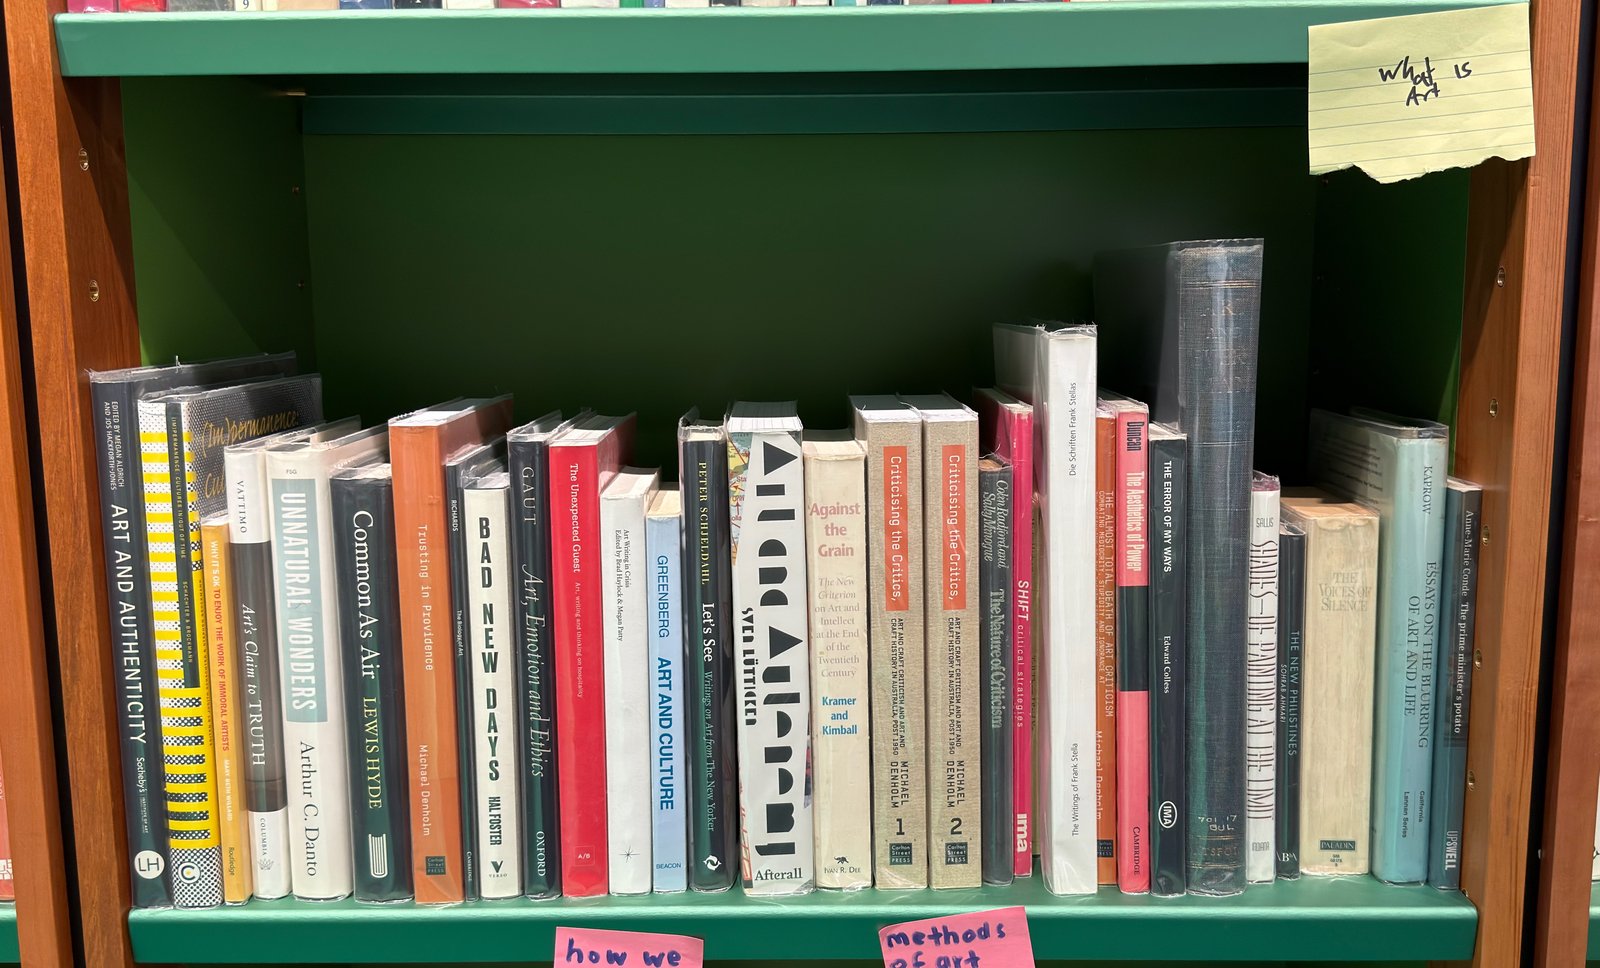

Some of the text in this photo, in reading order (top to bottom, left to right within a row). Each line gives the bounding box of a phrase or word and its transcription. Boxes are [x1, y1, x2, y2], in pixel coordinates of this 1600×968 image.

[1379, 56, 1435, 86] What
[1406, 82, 1440, 106] Art
[111, 401, 124, 488] EDITED BY MEGAN ALDRICH
[1069, 382, 1077, 476] Die Schriften Frank Stellas
[236, 480, 247, 533] VATTIMO
[521, 466, 537, 525] GAUT
[809, 502, 861, 519] Against
[1127, 422, 1145, 571] Duncan The Aesthetics of Power
[1422, 466, 1433, 514] KAPROW
[450, 500, 459, 532] RICHARDS
[570, 464, 582, 573] The Unexpected Guest
[699, 463, 710, 584] PETER SCHJELDAHL
[825, 522, 847, 536] the
[889, 456, 903, 601] Criticising the Critics,
[948, 455, 961, 600] Criticising the Critics,
[1164, 461, 1172, 573] THE ERROR OF MY WAYS
[818, 543, 854, 557] Grain
[281, 493, 318, 710] UNNATURAL WONDERS
[353, 510, 381, 679] Common As Air
[418, 525, 435, 671] Trusting in Providence
[1105, 491, 1114, 717] THE ALMOST TOTAL DEATH OF ART CRITICISM
[1321, 598, 1368, 612] SILENCE
[111, 504, 147, 744] ART AND AUTHENTICITY
[820, 615, 855, 625] Intellect
[479, 517, 500, 781] BAD NEW DAYS
[521, 564, 552, 777] Art, Emotion and Ethics
[818, 655, 860, 664] Twentieth
[1016, 580, 1029, 727] SHIFT critical strategies
[1404, 596, 1420, 716] OF ART AND LIFE
[1419, 561, 1437, 748] ESSAYS ON THE BLURRING
[657, 556, 674, 811] GREENBERG ART AND CULTURE
[821, 669, 856, 679] Century
[949, 670, 954, 678] IN
[1288, 631, 1299, 755] THE NEW PHILISTINES
[822, 696, 857, 706] Kramer
[831, 710, 849, 720] and
[363, 697, 382, 809] LEWIS HYDE
[822, 725, 858, 735] Kimball
[418, 745, 432, 836] Michael Denholm
[891, 761, 899, 808] DENHOLM
[900, 761, 909, 805] MICHAEL
[947, 761, 955, 808] DENHOLM
[957, 760, 965, 804] MICHAEL
[300, 742, 320, 877] Arthur C. Danto
[489, 797, 502, 845] HAL FOSTER
[896, 819, 905, 835] 1
[951, 818, 962, 834] 2
[1163, 806, 1172, 825] IMA
[536, 831, 547, 877] OXFORD
[1445, 830, 1459, 870] UPSWELL
[754, 869, 803, 880] Afterall
[566, 938, 681, 967] how we
[886, 922, 1006, 948] methods
[890, 950, 981, 968] of art
